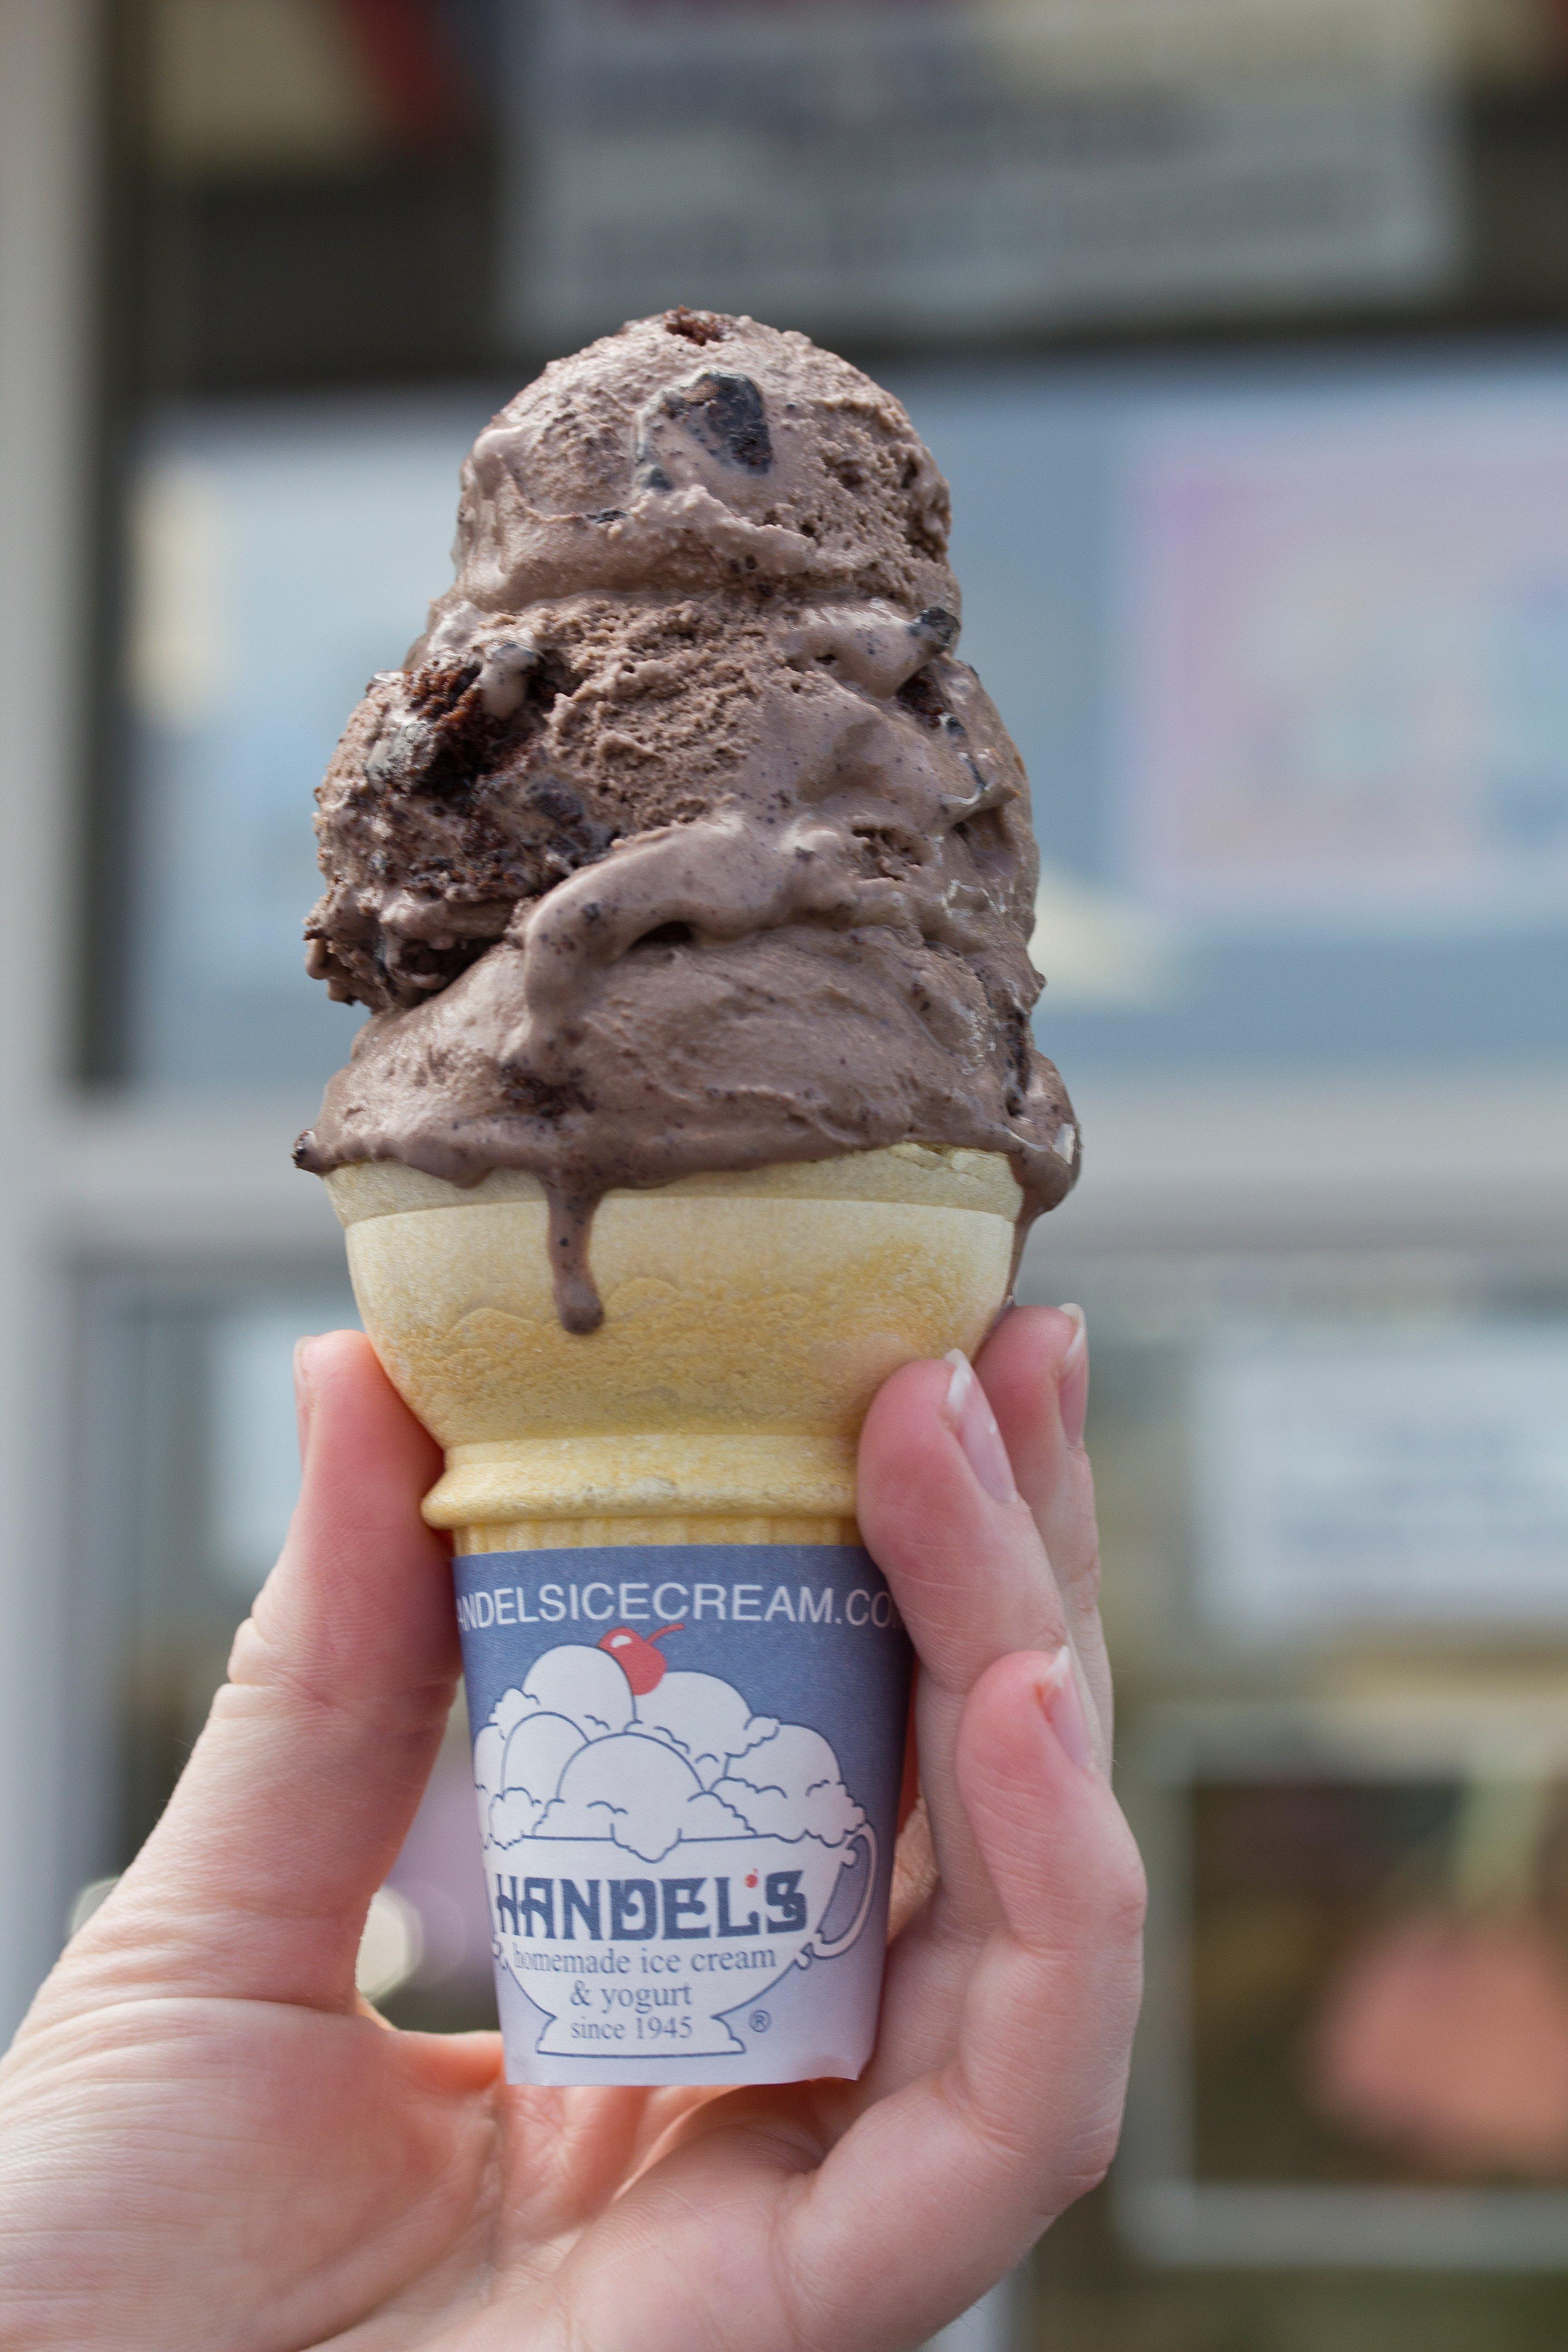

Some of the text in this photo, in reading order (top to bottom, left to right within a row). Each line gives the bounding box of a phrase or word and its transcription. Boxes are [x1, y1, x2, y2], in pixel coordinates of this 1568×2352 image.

[495, 1868, 808, 1940] HANDEL'S
[513, 1942, 776, 1974] homemade ice cream
[569, 1979, 692, 2014] & yogurt
[571, 2015, 692, 2039] since 1945
